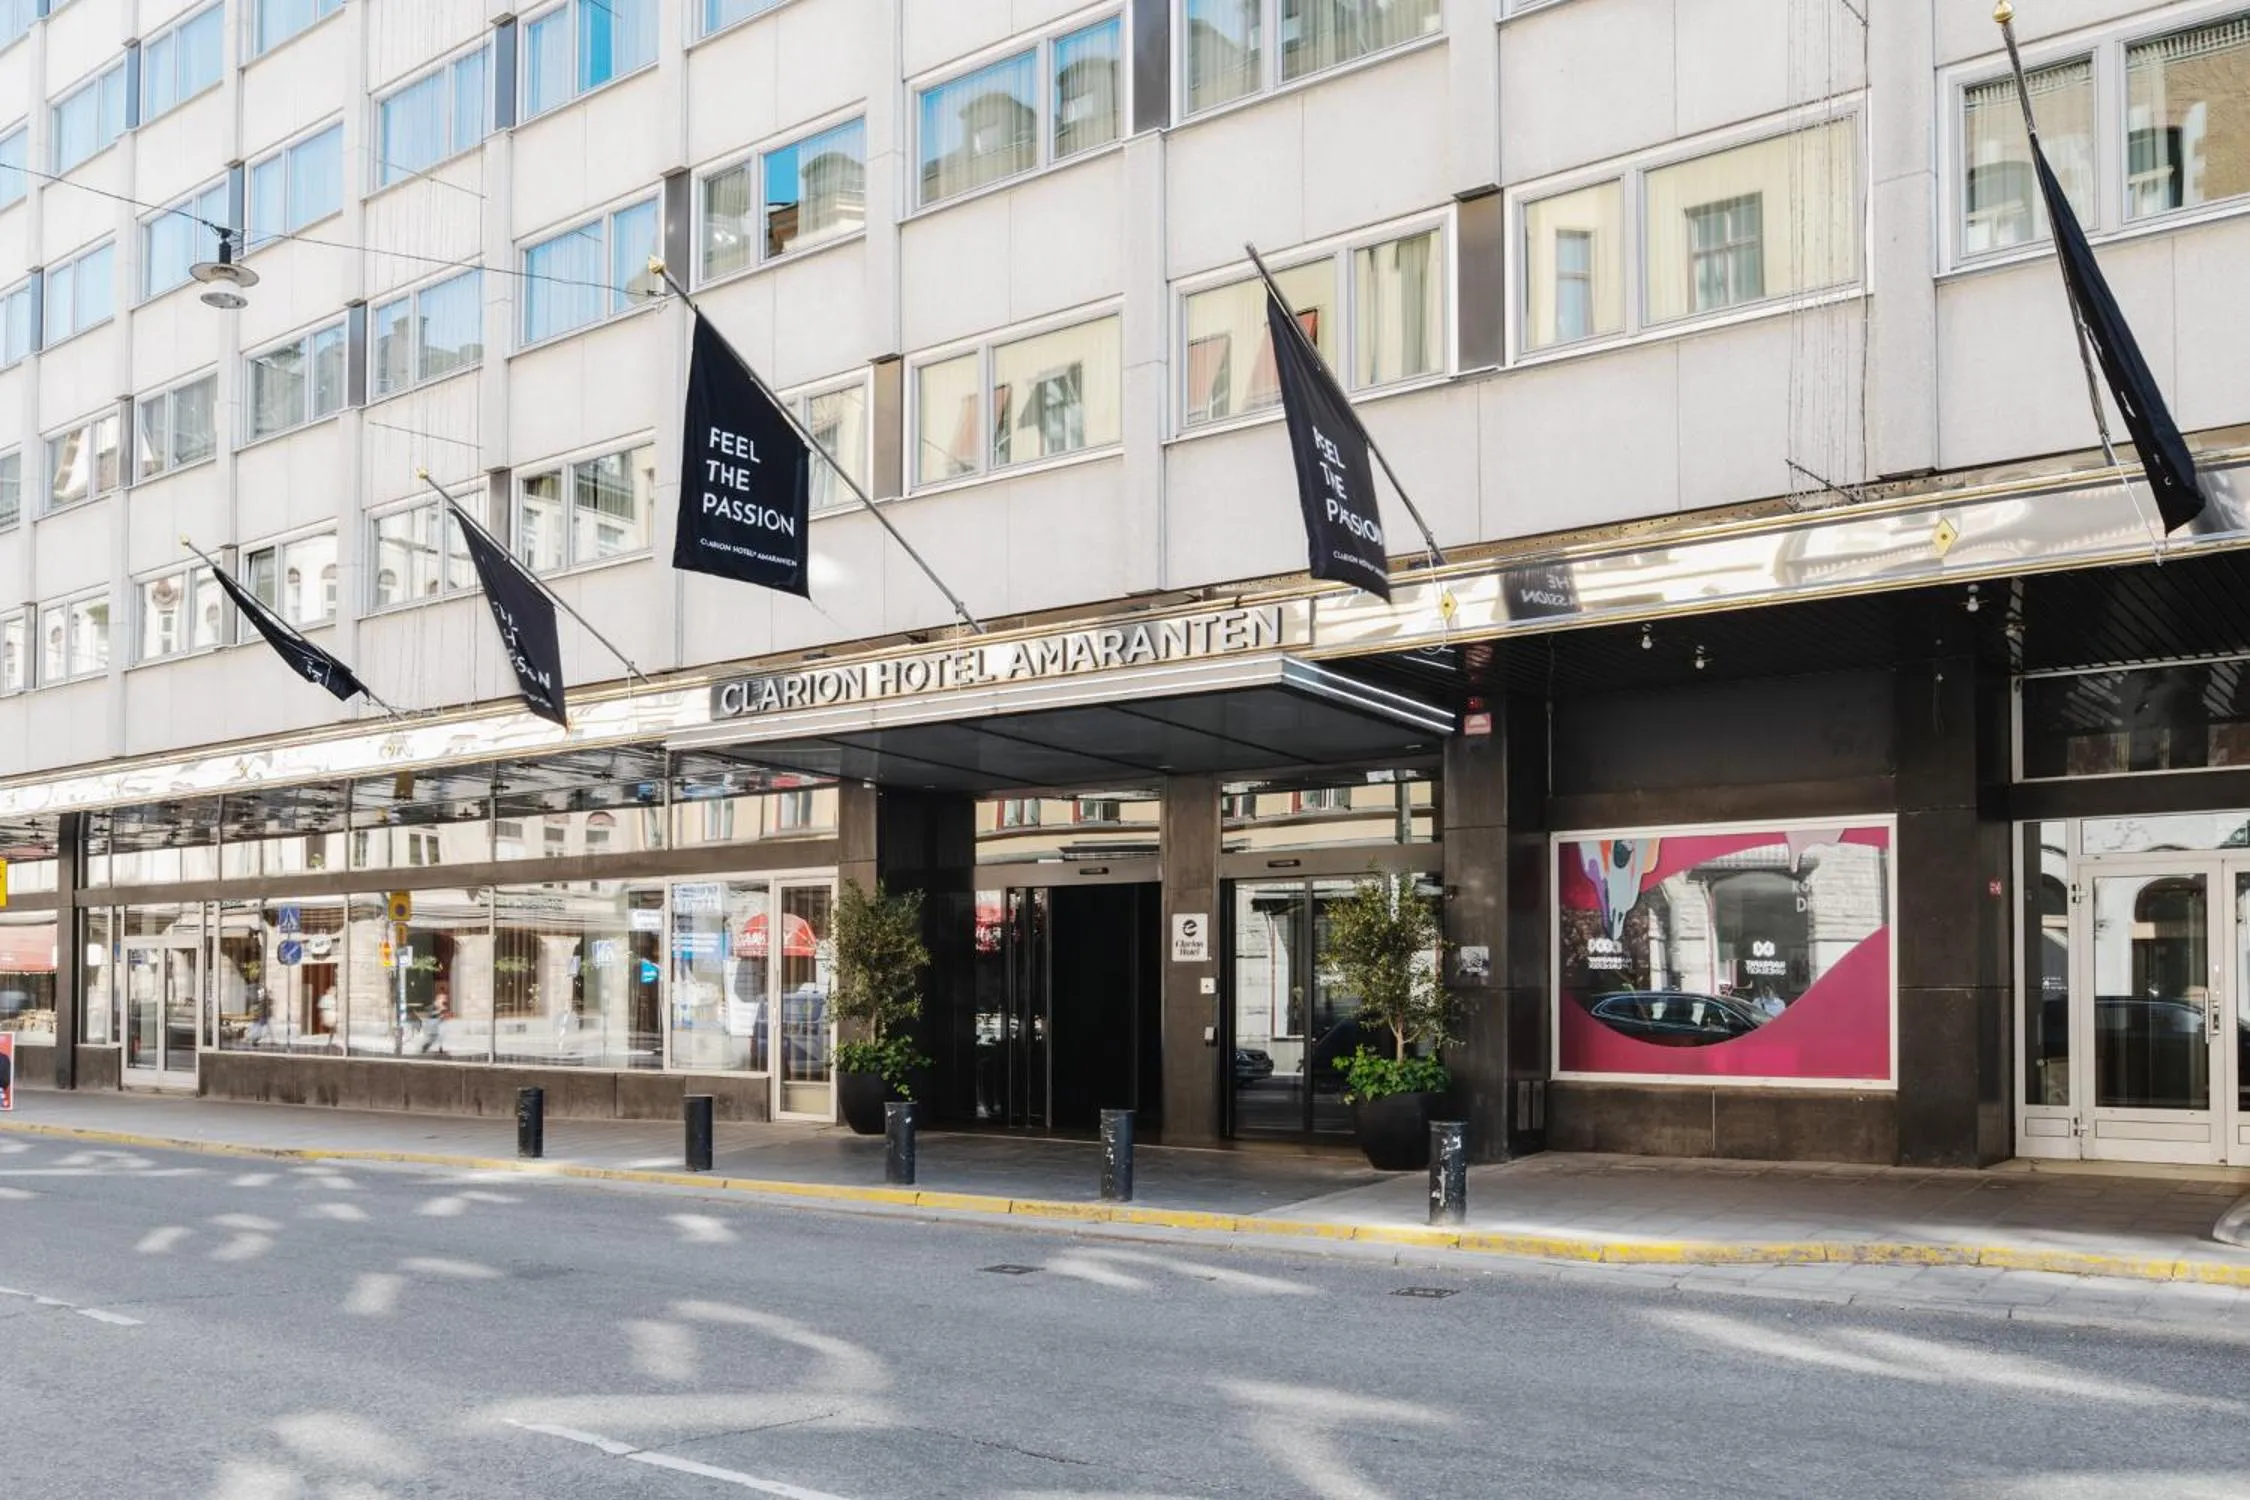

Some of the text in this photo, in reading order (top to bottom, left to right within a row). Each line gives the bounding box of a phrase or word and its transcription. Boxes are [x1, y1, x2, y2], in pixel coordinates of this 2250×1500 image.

[709, 426, 761, 463] FEEL
[706, 459, 750, 492] THE
[702, 492, 795, 537] PASSION
[720, 605, 1283, 715] CLARION HOTEL AMARANTEN
